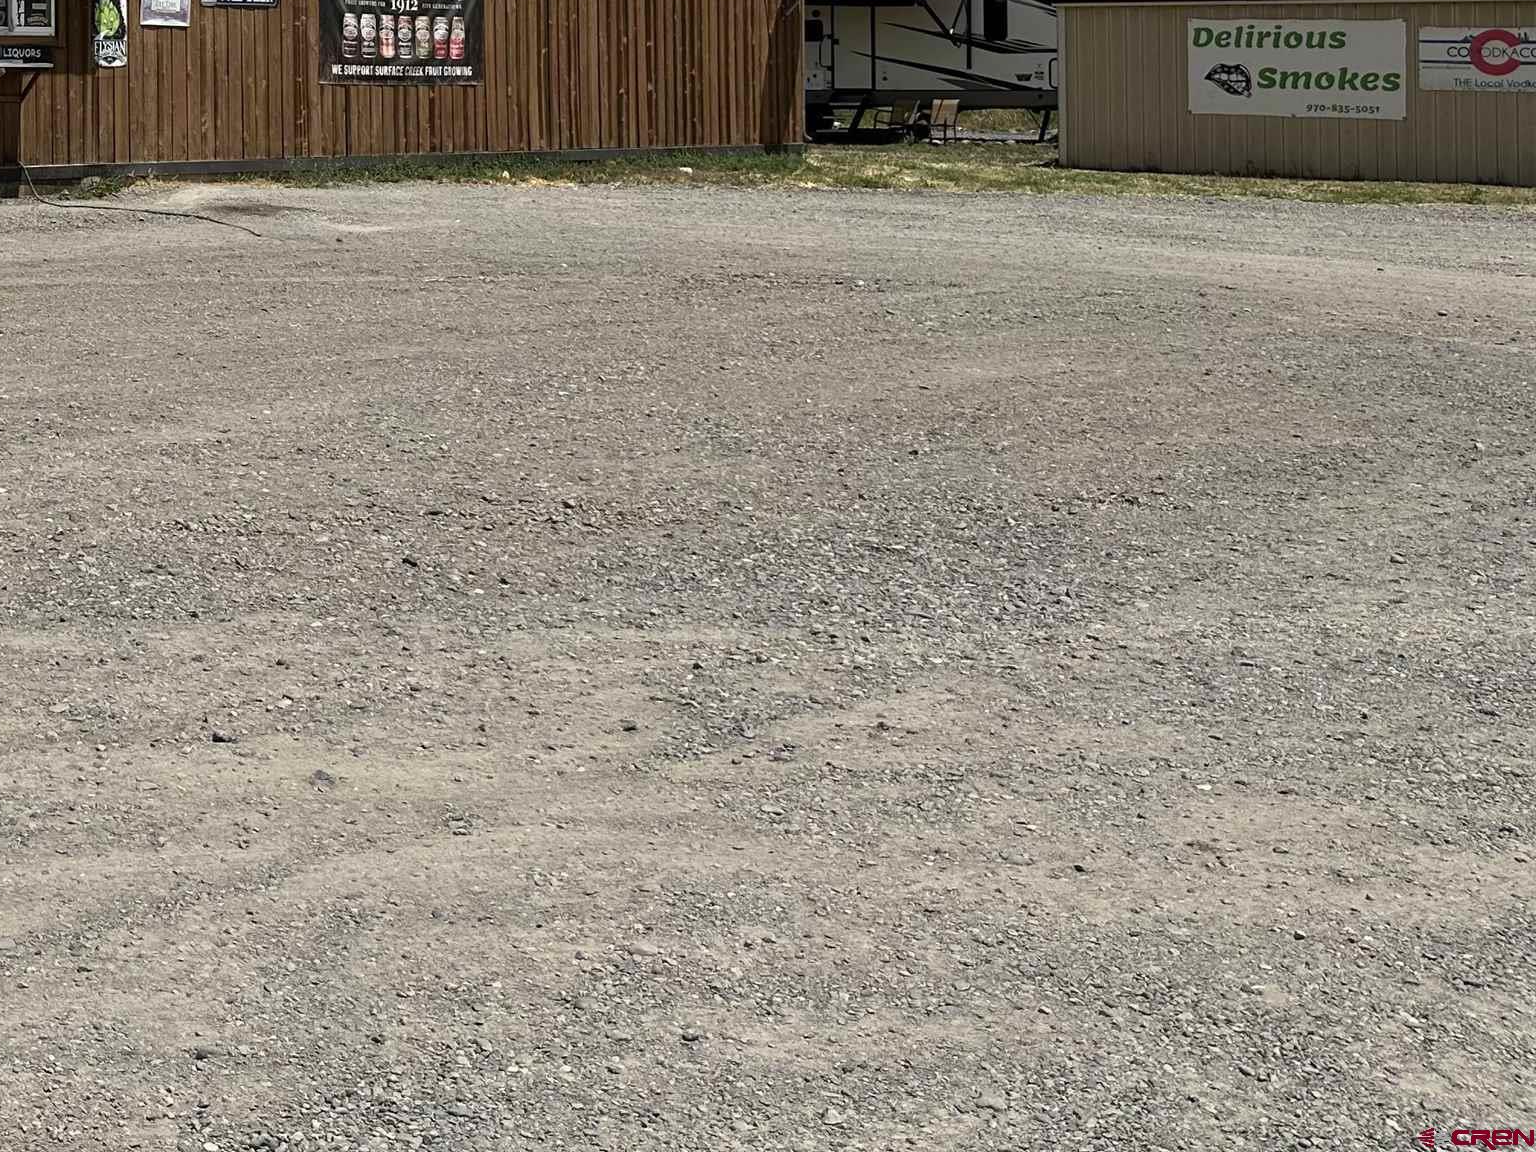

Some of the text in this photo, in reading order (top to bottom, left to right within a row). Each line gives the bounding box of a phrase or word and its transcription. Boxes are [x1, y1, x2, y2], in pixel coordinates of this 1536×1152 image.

[1192, 24, 1347, 49] Delirious
[2, 48, 42, 59] LIQUORS
[94, 39, 127, 57] ELYSIAN
[332, 64, 343, 75] WE
[343, 64, 374, 76] SUPPORT
[374, 65, 404, 76] SURFACE
[425, 66, 443, 76] FRUIT
[1256, 66, 1401, 92] Smokes
[1454, 78, 1473, 87] THE
[1474, 78, 1504, 88] Local
[1305, 103, 1381, 113] 970-835-5051
